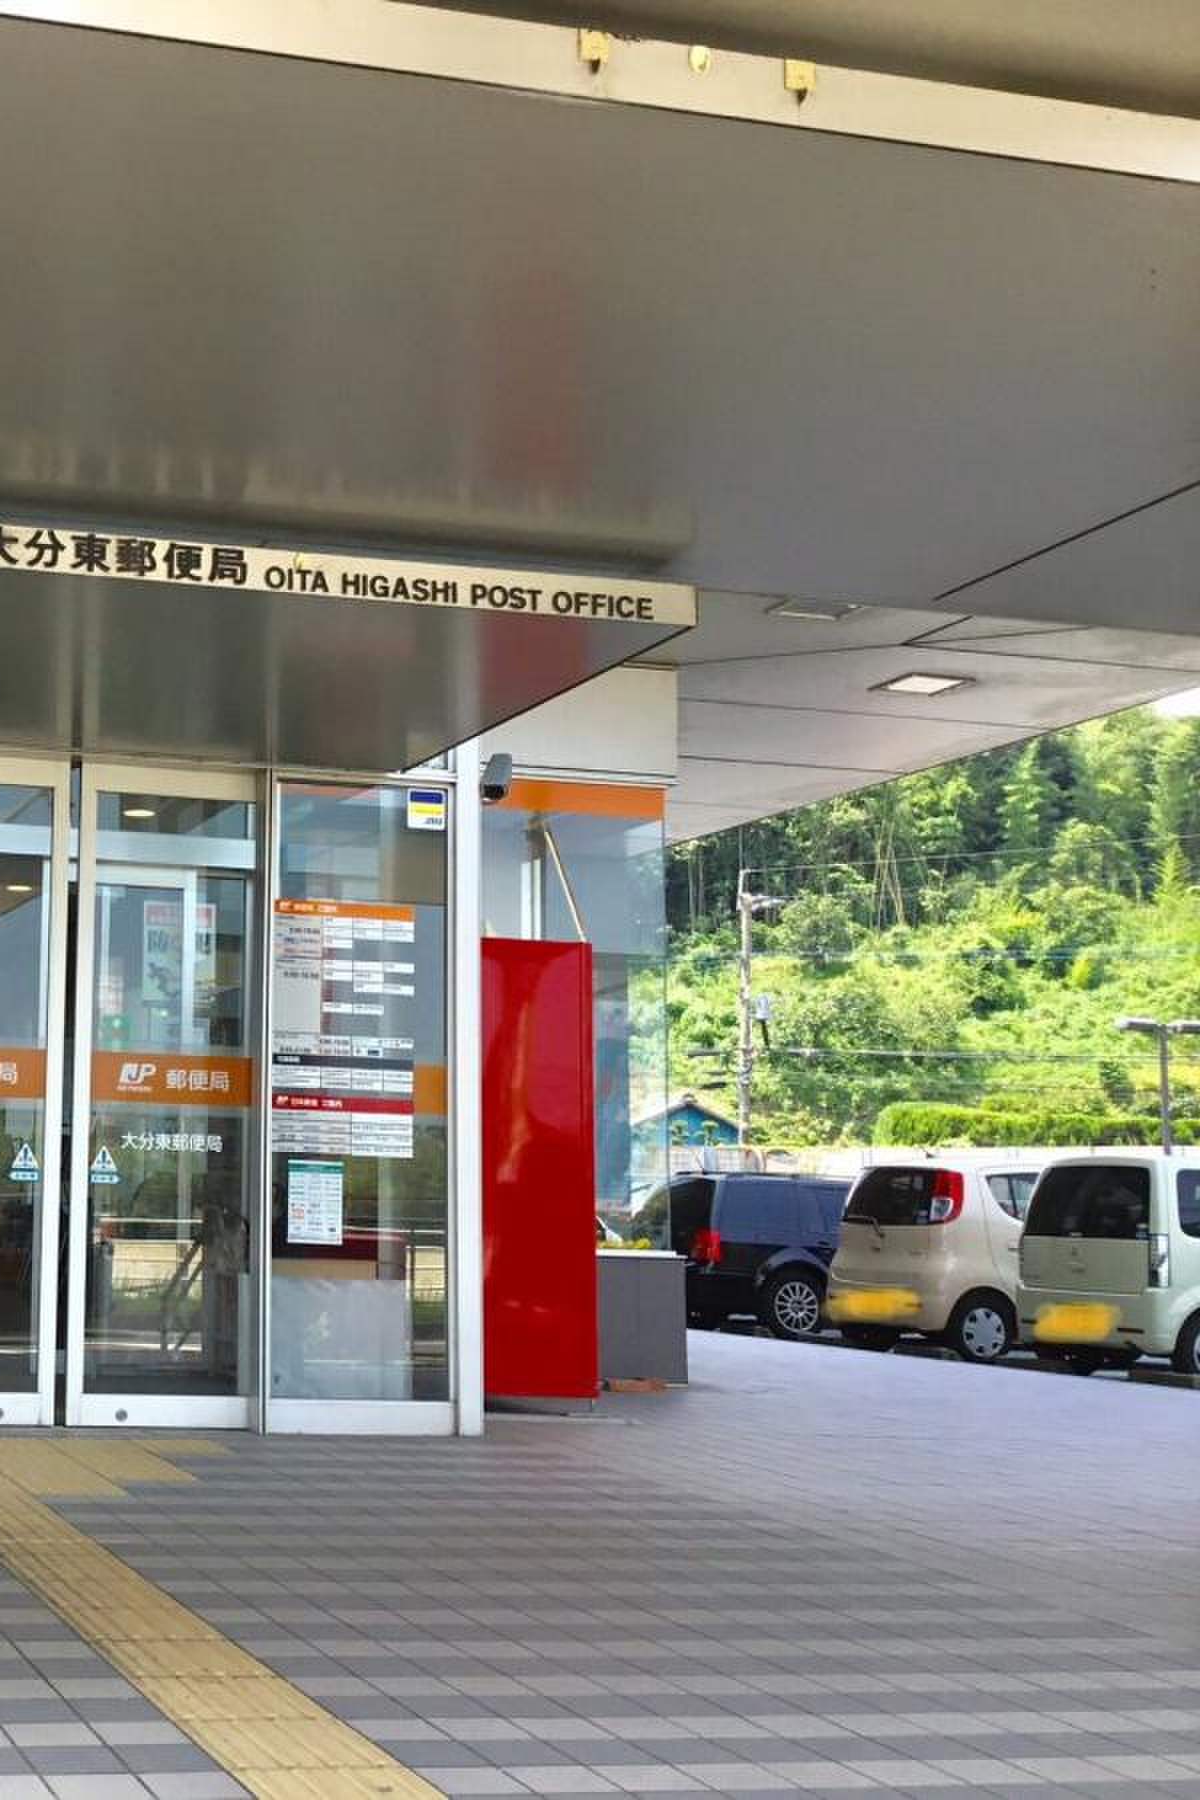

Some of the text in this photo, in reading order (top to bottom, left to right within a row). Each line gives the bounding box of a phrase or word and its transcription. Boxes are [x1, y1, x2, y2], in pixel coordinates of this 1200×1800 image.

[265, 566, 654, 620] OITA HIGASHI POST OFFICE
[166, 1069, 230, 1093] 郵便局
[120, 1132, 224, 1153] 大分東郵便局
